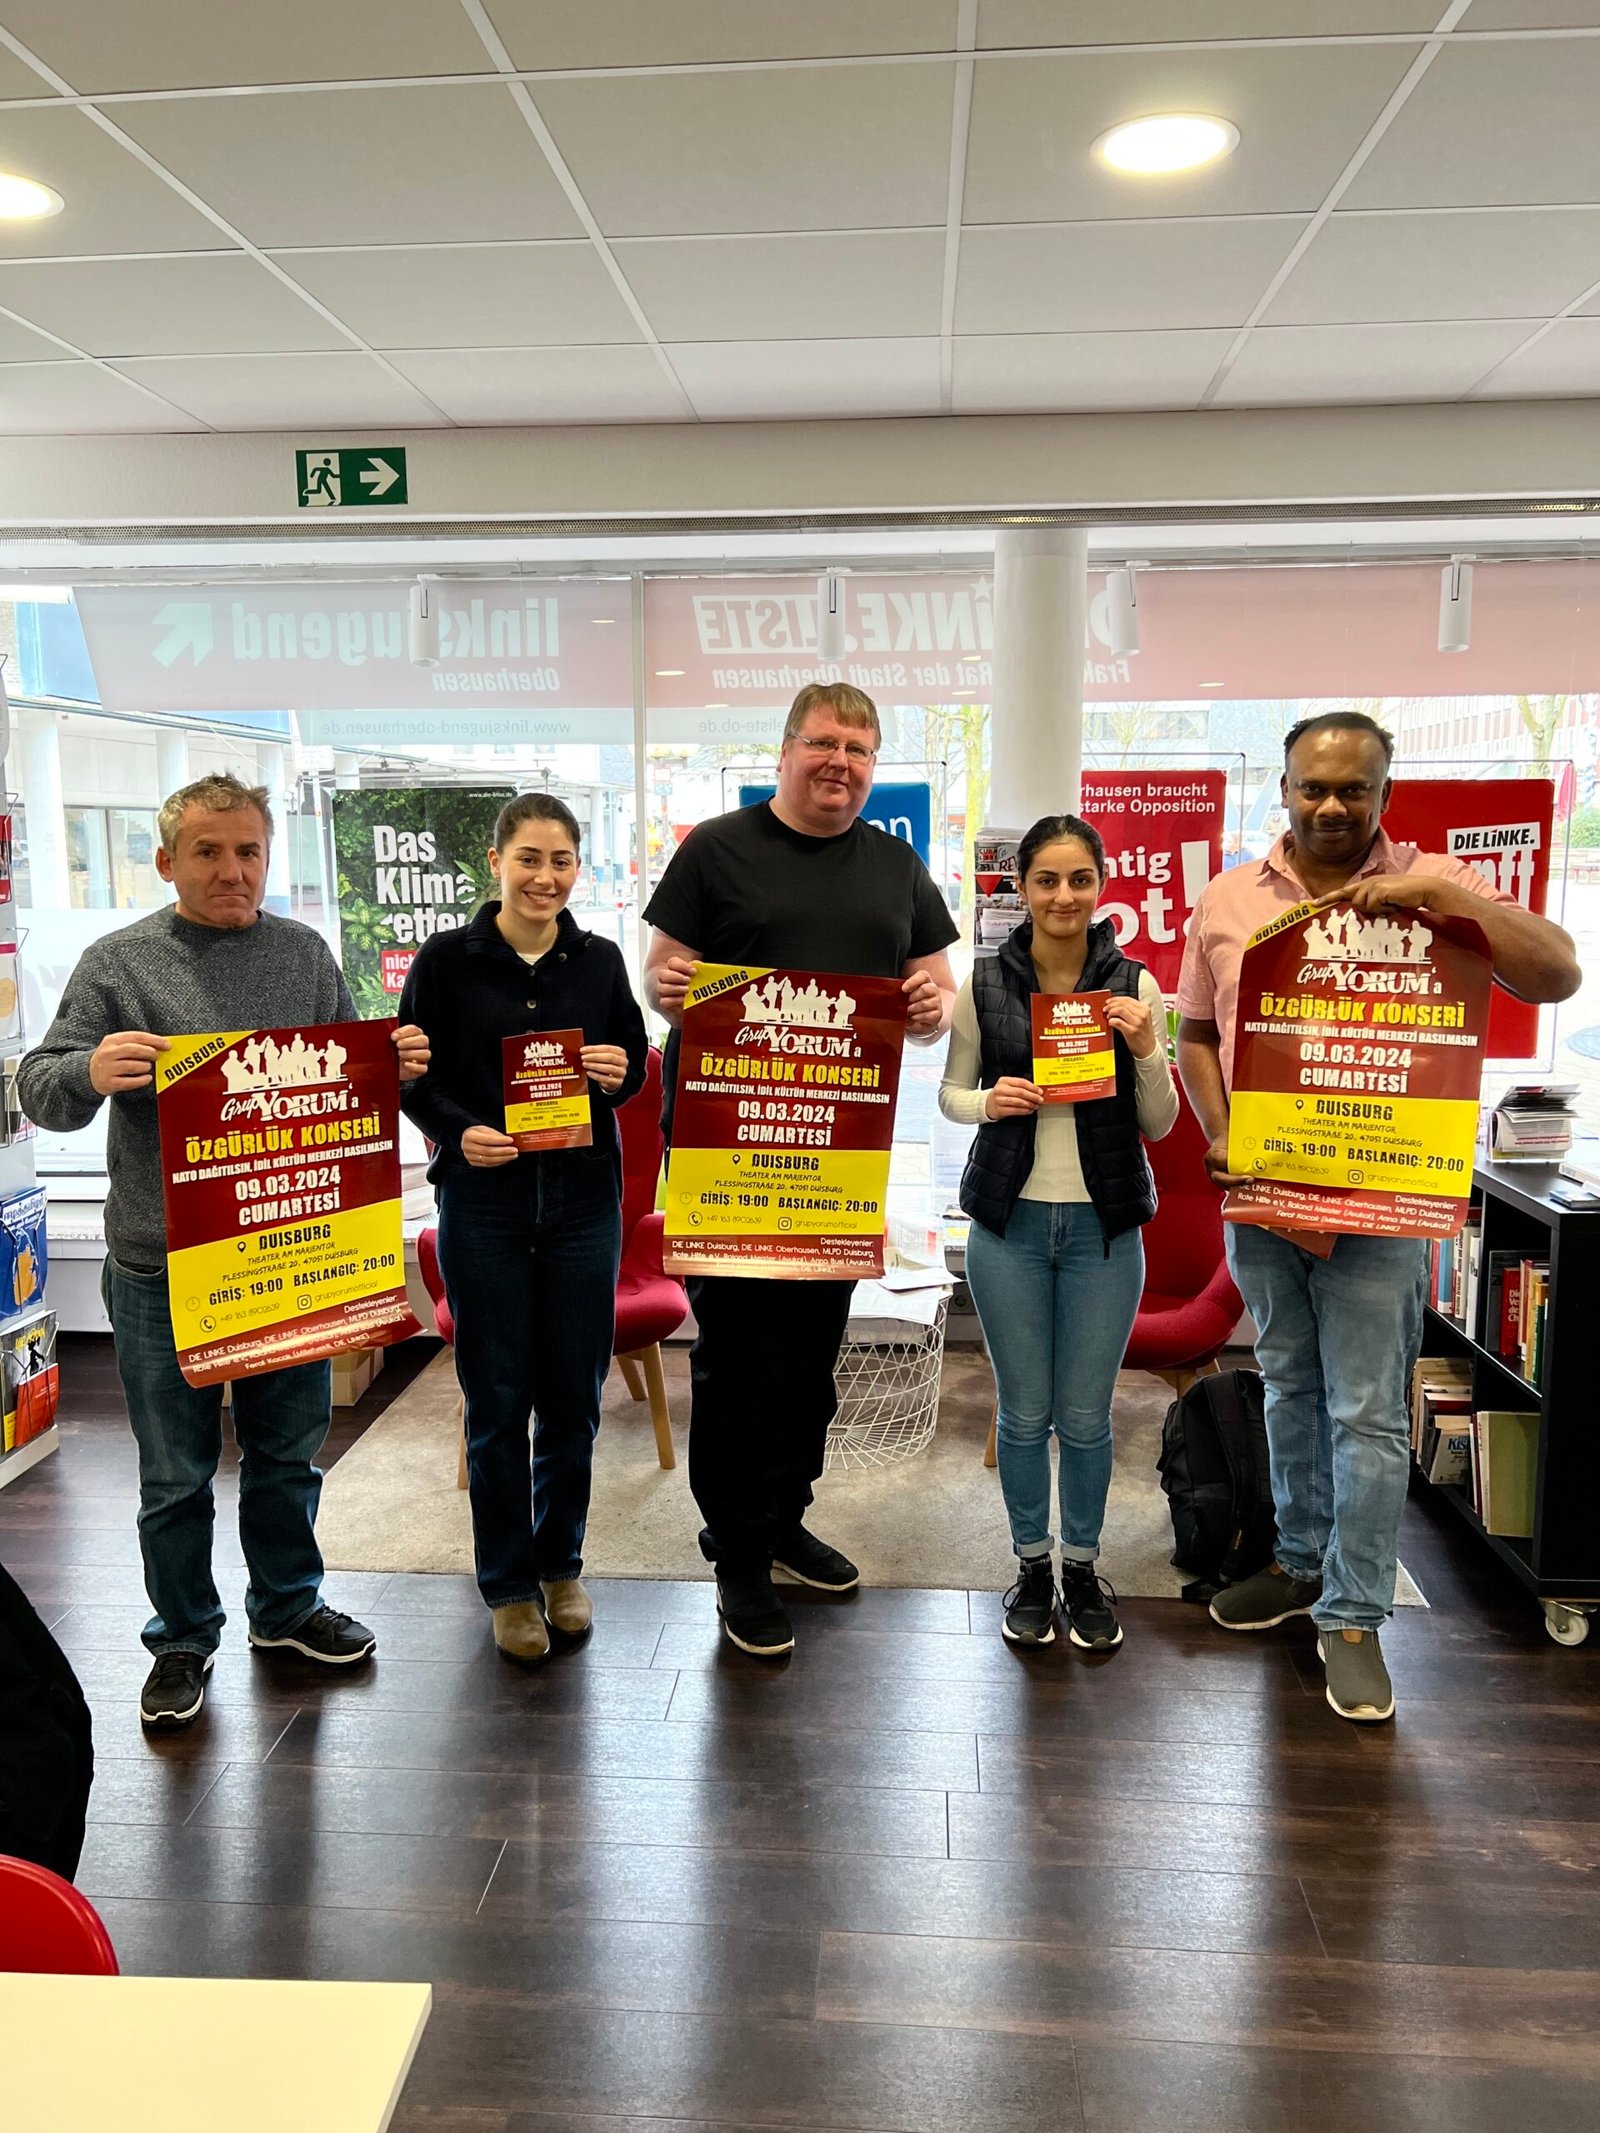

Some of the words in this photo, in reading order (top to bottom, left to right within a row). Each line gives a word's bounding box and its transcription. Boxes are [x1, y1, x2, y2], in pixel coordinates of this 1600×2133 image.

[1147, 783, 1208, 797] braucht
[1129, 800, 1216, 816] Opposition
[373, 825, 437, 864] Das
[1453, 832, 1480, 851] DIE
[1255, 904, 1310, 942] DUISBURG
[692, 970, 749, 1002] DUISBURG
[1296, 963, 1336, 985] Grup
[1260, 991, 1366, 1022] ÖZGÜRLÜK
[1372, 1001, 1465, 1028] KONSERİ
[735, 1026, 769, 1047] Grup
[1245, 1021, 1269, 1033] NATO
[1340, 1026, 1375, 1040] KÜLTÜR
[1376, 1029, 1418, 1043] MERKEZİ
[1418, 1031, 1478, 1047] BASILMASIN
[164, 1037, 227, 1082] DUISBURG
[1299, 1042, 1412, 1069] 09.03.2024
[700, 1052, 796, 1082] ÖZGÜRLÜK
[802, 1064, 881, 1088] KONSERİ
[1299, 1067, 1409, 1094] CUMARTESİ
[685, 1080, 708, 1092] NATO
[757, 1084, 773, 1096] İDİL
[774, 1086, 805, 1098] KÜLTÜR
[806, 1089, 840, 1101] MERKEZİ
[841, 1091, 890, 1104] BASILMASIN
[220, 1096, 262, 1122] Grup
[737, 1100, 836, 1124] 09.03.2024
[1315, 1099, 1393, 1121] DUISBURG
[185, 1125, 294, 1163] ÖZGÜRLÜK
[301, 1112, 380, 1147] KONSERİ
[737, 1124, 833, 1146] CUMARTESİ
[1303, 1117, 1335, 1128] THEATER
[1337, 1120, 1349, 1129] AM
[1350, 1122, 1397, 1134] MARIENTOR
[1360, 1134, 1381, 1143] 47051
[172, 1170, 197, 1184] NATO
[253, 1157, 272, 1172] İDİL
[272, 1153, 306, 1169] KÜLTÜR
[306, 1146, 343, 1164] MERKEZİ
[344, 1140, 393, 1157] BASILMASIN
[752, 1153, 820, 1171] DUISBURG
[1302, 1142, 1336, 1158] 19:00
[1426, 1155, 1464, 1172] 20:00
[235, 1164, 342, 1201] 09.03.2024
[740, 1170, 769, 1180] THEATER
[771, 1172, 782, 1180] AM
[783, 1173, 822, 1182] MARIENTOR
[790, 1184, 808, 1192] 47051
[239, 1189, 341, 1226] CUMARTESİ
[700, 1190, 733, 1207] GİRİŞ:
[737, 1194, 769, 1208] 19:00
[778, 1197, 842, 1212] BAŞLANGIÇ:
[845, 1200, 878, 1213] 20:00
[1237, 1192, 1254, 1202] Rote
[1251, 1184, 1271, 1194] LINKE
[1273, 1187, 1307, 1201] Duisburg,
[1308, 1193, 1321, 1202] DIE
[1322, 1196, 1344, 1206] LINKE
[1394, 1206, 1417, 1216] MLPD
[1394, 1195, 1457, 1210] Destekleyenler:
[259, 1224, 331, 1251] DUISBURG
[672, 1240, 684, 1249] DIE
[685, 1241, 705, 1250] LINKE
[706, 1242, 740, 1252] Duisburg,
[741, 1243, 753, 1252] DIE
[754, 1244, 773, 1252] LINKE
[775, 1245, 820, 1256] Oberhausen,
[822, 1247, 842, 1256] MLPD
[820, 1237, 874, 1248] Destekleyenler:
[247, 1253, 280, 1266] THEATER
[281, 1249, 294, 1258] AM
[295, 1241, 336, 1257] MARIENTOR
[303, 1254, 324, 1265] 47051
[209, 1286, 246, 1306] GİRİŞ:
[249, 1277, 283, 1296] 19:00
[294, 1262, 360, 1287] BAŞLANGIÇ:
[363, 1253, 396, 1272] 20:00
[188, 1352, 203, 1364] DIE
[203, 1346, 226, 1360] LINKE
[263, 1333, 277, 1344] DIE
